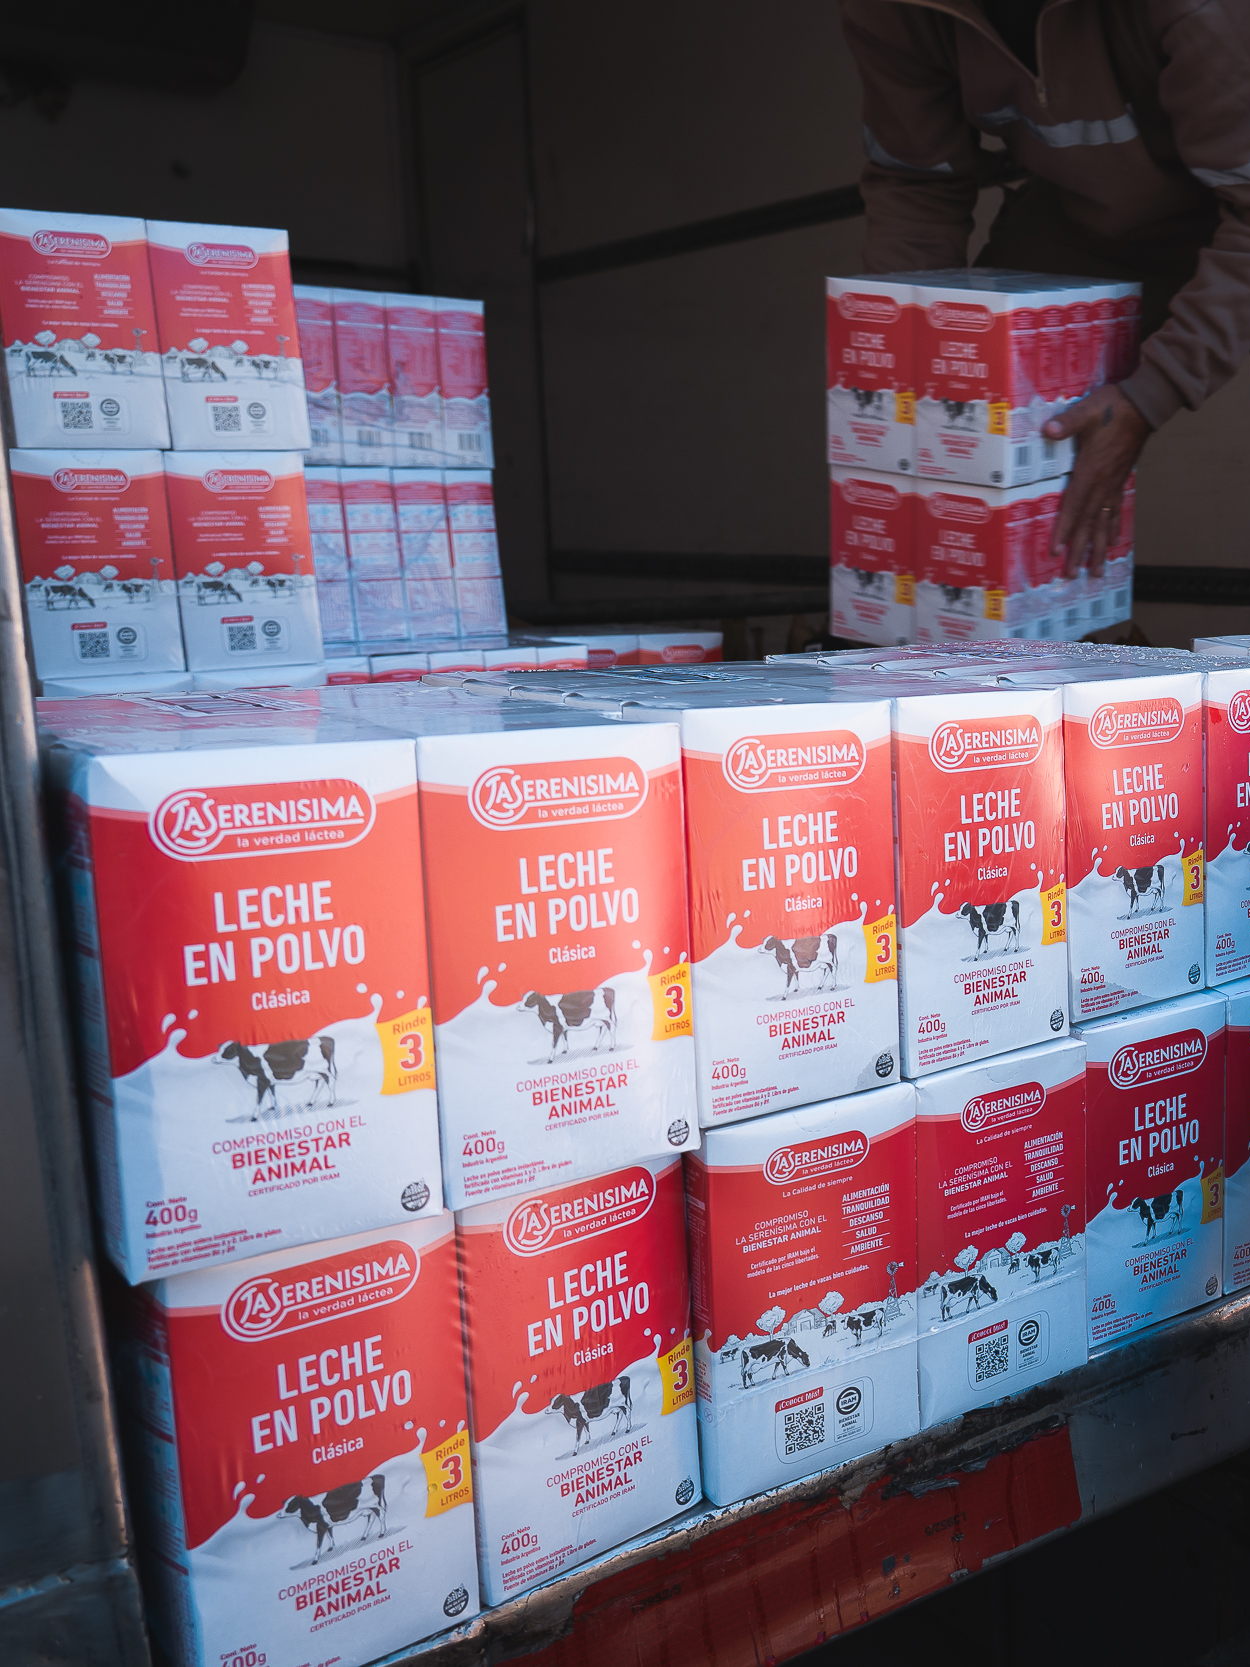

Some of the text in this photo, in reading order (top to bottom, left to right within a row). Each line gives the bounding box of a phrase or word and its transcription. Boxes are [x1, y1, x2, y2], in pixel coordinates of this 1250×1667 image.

[1115, 763, 1164, 796] LECHE
[961, 788, 1021, 825] LECHE
[1101, 793, 1177, 830] EN POLVO
[762, 810, 838, 850] LECHE
[944, 820, 1037, 863] EN POLVO
[519, 847, 615, 895] LECHE
[742, 846, 857, 892] EN POLVO
[213, 880, 334, 934] LECHE
[494, 887, 640, 943] EN POLVO
[1119, 928, 1169, 950] BIENESTAR
[1127, 942, 1162, 961] ANIMAL
[182, 924, 366, 988] EN POLVO
[549, 941, 597, 965] Clásica
[965, 970, 1026, 995] BIENESTAR
[1081, 970, 1104, 986] 400g
[252, 985, 312, 1011] Clásica
[974, 986, 1017, 1007] ANIMAL
[769, 1010, 845, 1038] BIENESTAR
[918, 1018, 946, 1036] 400g
[781, 1027, 834, 1051] ANIMAL
[711, 1062, 746, 1082] 400g
[533, 1073, 628, 1107] BIENESTAR
[548, 1092, 615, 1121] ANIMAL
[1134, 1093, 1187, 1132] LECHE
[232, 1131, 352, 1170] BIENESTAR
[461, 1136, 505, 1158] 400g
[1025, 1129, 1063, 1149] ALIMENTACIÓN
[1025, 1144, 1063, 1161] TRANQUILIDAD
[1119, 1119, 1199, 1166] EN POLVO
[252, 1153, 336, 1185] ANIMAL
[810, 1163, 832, 1172] verdad
[834, 1157, 853, 1166] láctea
[953, 1156, 997, 1176] COMPROMISO
[1031, 1158, 1058, 1172] DESCANSO
[1036, 1172, 1053, 1183] SALUD
[792, 1185, 816, 1195] Calidad
[827, 1176, 852, 1187] siempre
[842, 1181, 889, 1202] ALIMENTACIÓN
[944, 1171, 1007, 1197] BIENESTAR ANIMAL
[1031, 1183, 1058, 1197] AMBIENTE
[143, 1202, 198, 1228] 400g
[842, 1195, 889, 1215] TRANQUILIDAD
[563, 1207, 636, 1237] la verdad láctea
[735, 1235, 746, 1244] LA
[799, 1218, 815, 1227] CON
[818, 1213, 827, 1222] EL
[754, 1209, 808, 1231] COMPROMISO
[849, 1212, 883, 1227] DESCANSO
[856, 1227, 876, 1239] SALUD
[743, 1226, 821, 1253] BIENESTAR ANIMAL
[787, 1250, 798, 1259] IRAM
[800, 1247, 809, 1256] bajo
[850, 1238, 883, 1254] AMBIENTE
[747, 1269, 765, 1278] modelo
[782, 1260, 793, 1268] cinco
[1134, 1247, 1187, 1276] BIENESTAR
[1142, 1262, 1179, 1285] ANIMAL
[547, 1250, 629, 1310] LECHE
[769, 1290, 775, 1298] La
[777, 1286, 792, 1297] mejor
[794, 1281, 807, 1291] leche
[809, 1278, 815, 1286] de
[817, 1275, 831, 1284] vacas
[833, 1270, 843, 1279] bien
[527, 1281, 651, 1358] EN POLVO
[574, 1337, 614, 1367] Clásica
[668, 1345, 690, 1366] Rinde
[278, 1333, 384, 1402] LECHE
[672, 1358, 689, 1394] 3
[251, 1367, 412, 1455] EN POLVO
[672, 1391, 693, 1406] LITROS
[547, 1434, 652, 1489] COMPROMISO CON EL
[561, 1449, 642, 1498] BIENESTAR
[572, 1484, 634, 1518] CERTIFICADO POR IRAM
[574, 1469, 631, 1507] ANIMAL
[500, 1531, 538, 1558] 400g
[501, 1546, 540, 1566] Industria Argentina
[295, 1555, 401, 1611] BIENESTAR
[312, 1578, 387, 1621] ANIMAL
